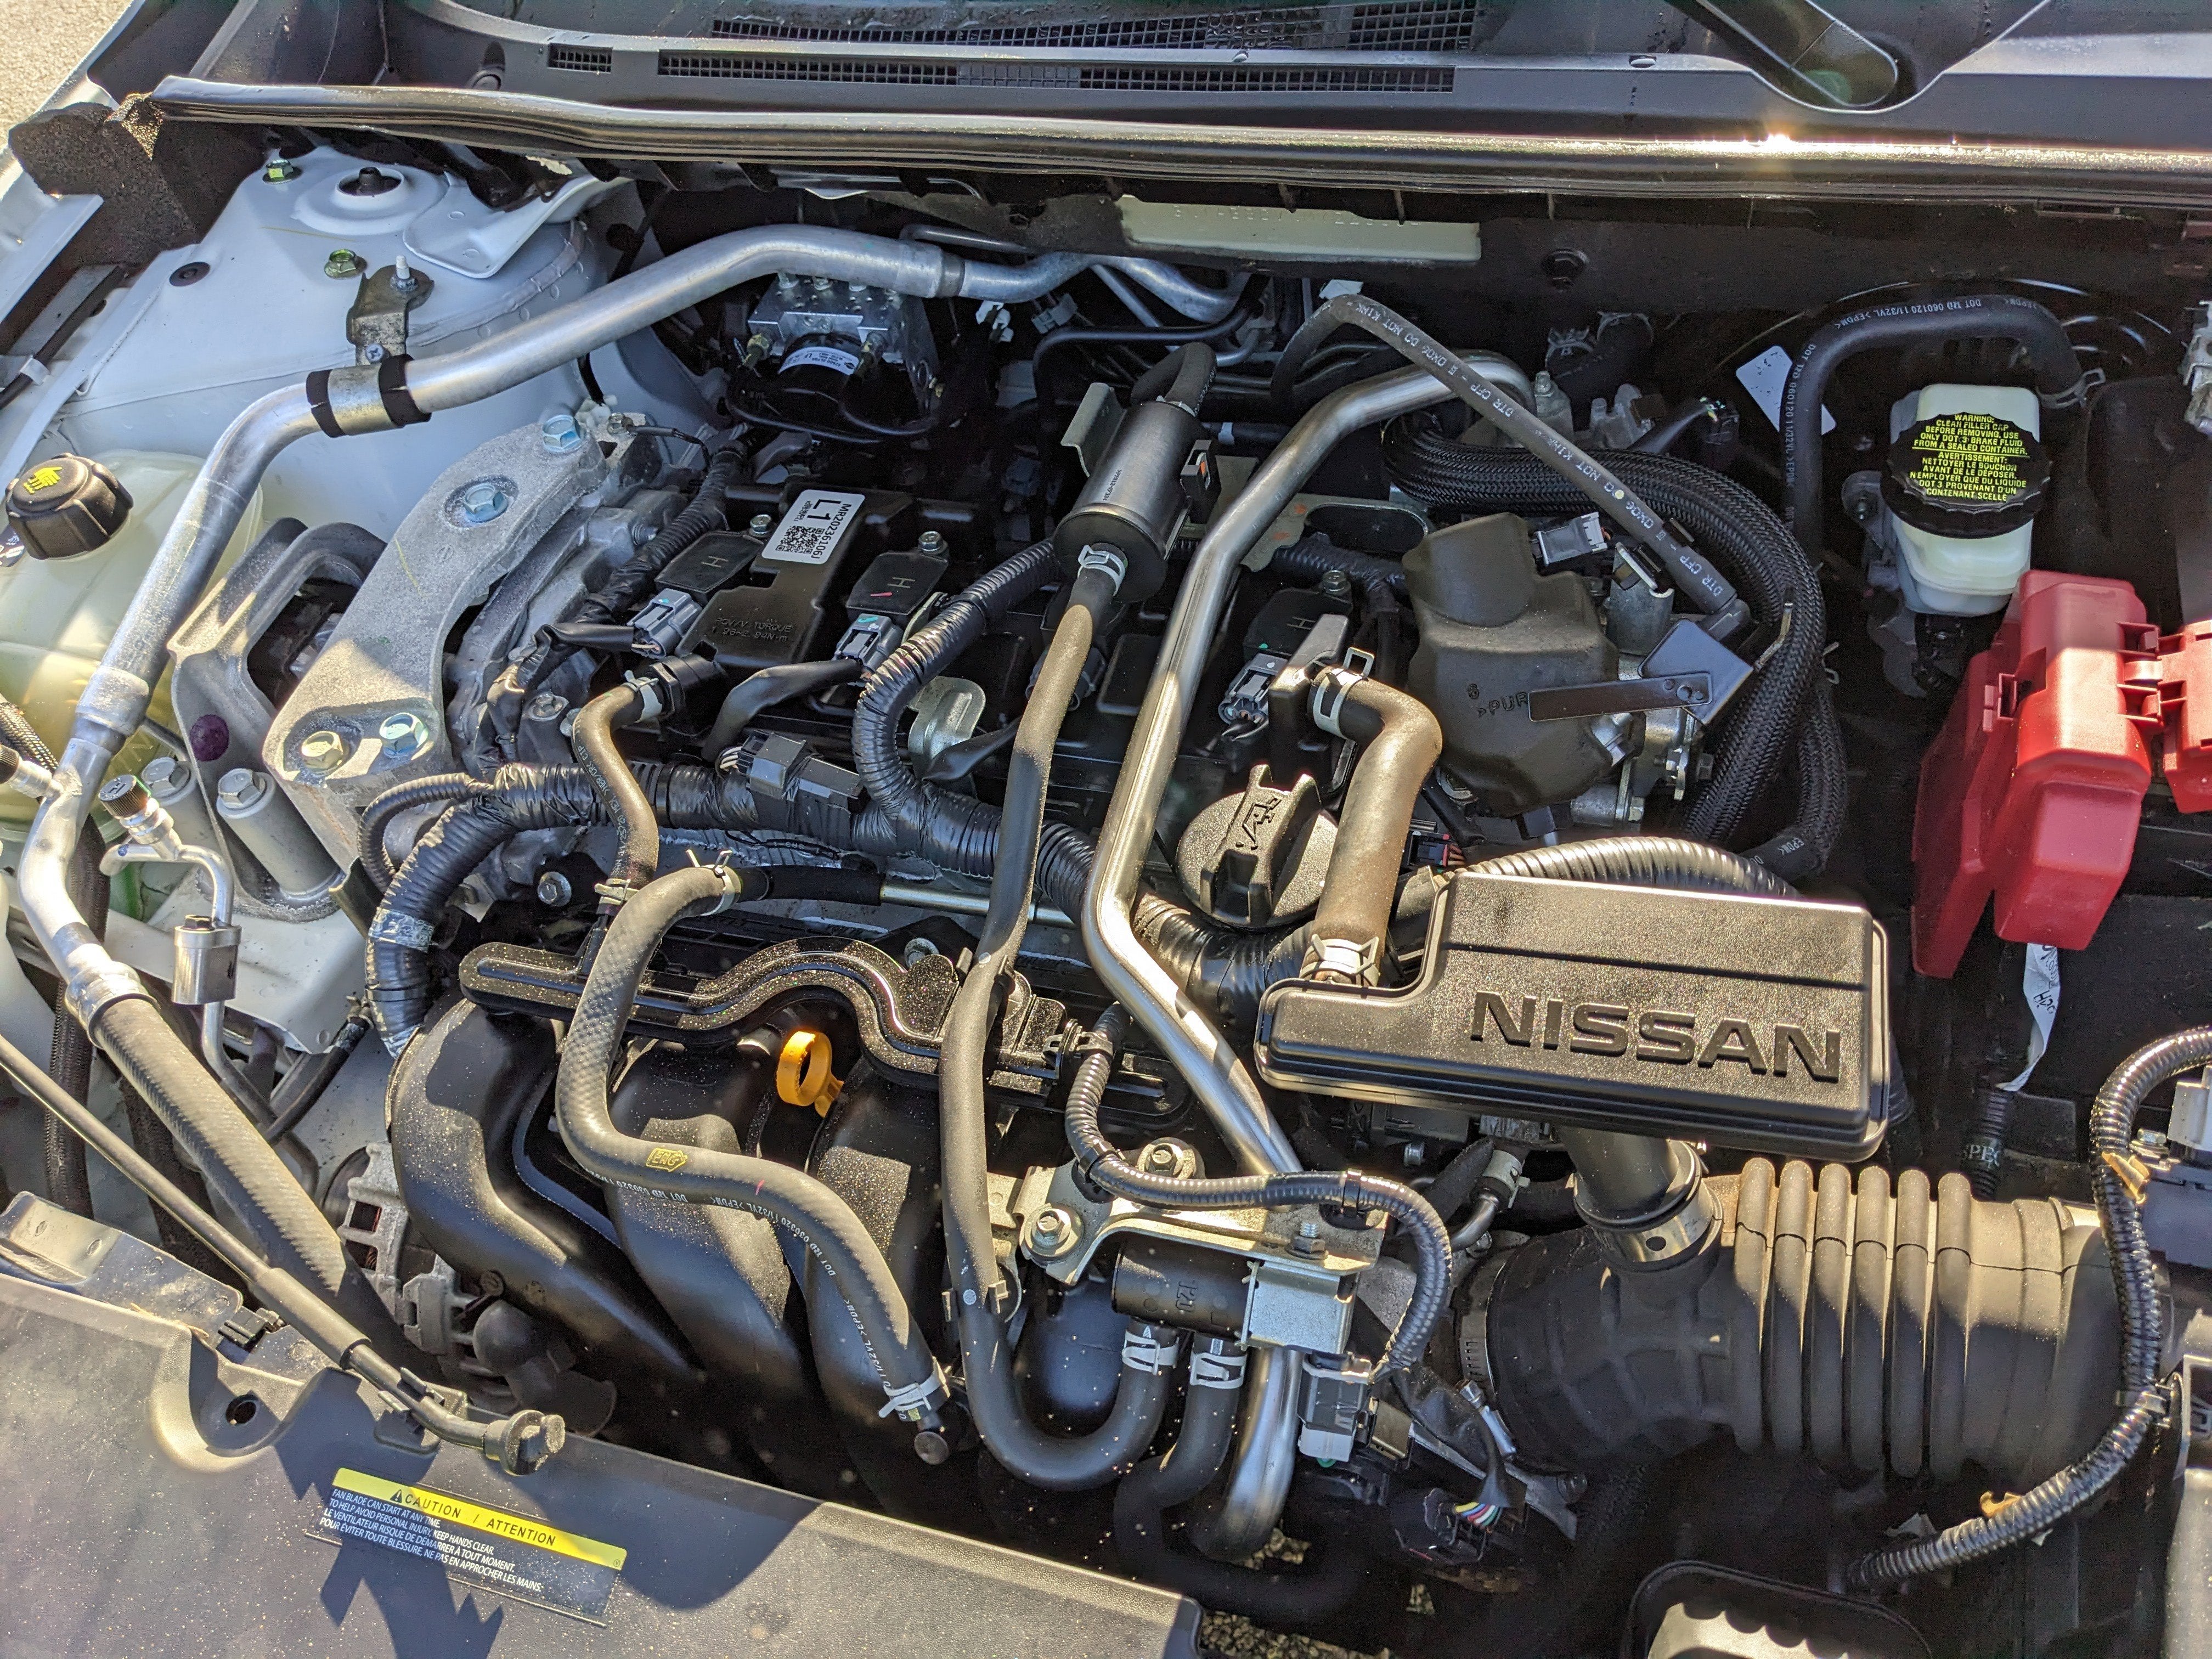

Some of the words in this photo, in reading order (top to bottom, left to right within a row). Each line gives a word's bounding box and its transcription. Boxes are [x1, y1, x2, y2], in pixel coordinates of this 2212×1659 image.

[1911, 303, 1944, 313] 060120
[1965, 299, 1982, 308] DOT
[1383, 319, 1403, 335] NOT
[1404, 333, 1420, 347] DO
[1802, 344, 1816, 361] DOT
[1785, 382, 1797, 417] 060120
[1955, 415, 1994, 423] WARNING:
[1963, 421, 1990, 430] FILLER
[1926, 426, 1956, 435] BEFORE
[1971, 437, 1997, 445] BRAKE
[1948, 443, 1978, 451] SEALED
[1980, 445, 2028, 455] CONTAINER.
[1922, 458, 1964, 466] NETTOYER
[1979, 462, 2016, 471] BOUCHON
[1938, 452, 2007, 463] AVERTISSEMENT:
[1576, 461, 1601, 481] NOT
[1923, 465, 1950, 474] AVANT
[1945, 482, 1995, 492] PROVENANT
[1963, 476, 1979, 484] QUE
[1995, 479, 2026, 488] LIQUIDE
[1926, 488, 1975, 499] CONTENANT
[807, 499, 842, 521] L1
[811, 504, 852, 559] MR20236106J
[1470, 991, 1841, 1083] NISSAN
[652, 1150, 680, 1166] ENG
[670, 1192, 689, 1203] DOT
[781, 1217, 809, 1243] 030320
[821, 1260, 836, 1277] DOT
[331, 1489, 346, 1499] FAN
[345, 1493, 367, 1505] BLADE
[366, 1499, 382, 1509] CAN
[381, 1503, 402, 1516] START
[400, 1509, 410, 1518] AT
[409, 1511, 425, 1522] ANY
[424, 1516, 442, 1527] TIME.
[329, 1498, 339, 1508] TO
[338, 1501, 356, 1513] HELP
[354, 1506, 376, 1519] AVOID
[375, 1512, 409, 1528] PERSONAL
[408, 1522, 432, 1536] INJURY,
[432, 1530, 449, 1541] KEEP
[448, 1534, 473, 1548] HANDS
[472, 1541, 495, 1554] CLEAR.
[405, 1493, 461, 1518] CAUTION
[486, 1517, 556, 1547] ATTENTION
[323, 1508, 334, 1517] LE
[332, 1511, 379, 1530] VENTILATEUR
[377, 1524, 405, 1539] RISQUE
[404, 1532, 416, 1542] DE
[415, 1534, 455, 1554] DÉMARRER
[453, 1545, 461, 1555] À
[460, 1549, 482, 1562] TOUT
[480, 1555, 516, 1572] MOMENT.
[319, 1517, 341, 1530] POUR
[340, 1522, 366, 1537] ÉVITER
[364, 1531, 388, 1544] TOUTE
[387, 1538, 424, 1556] BLESSURE,
[424, 1549, 435, 1558] NE
[434, 1552, 449, 1563] PAS
[448, 1556, 460, 1566] EN
[459, 1560, 503, 1579] APPROCHER
[503, 1573, 516, 1583] LES
[516, 1577, 544, 1591] MAINS.
